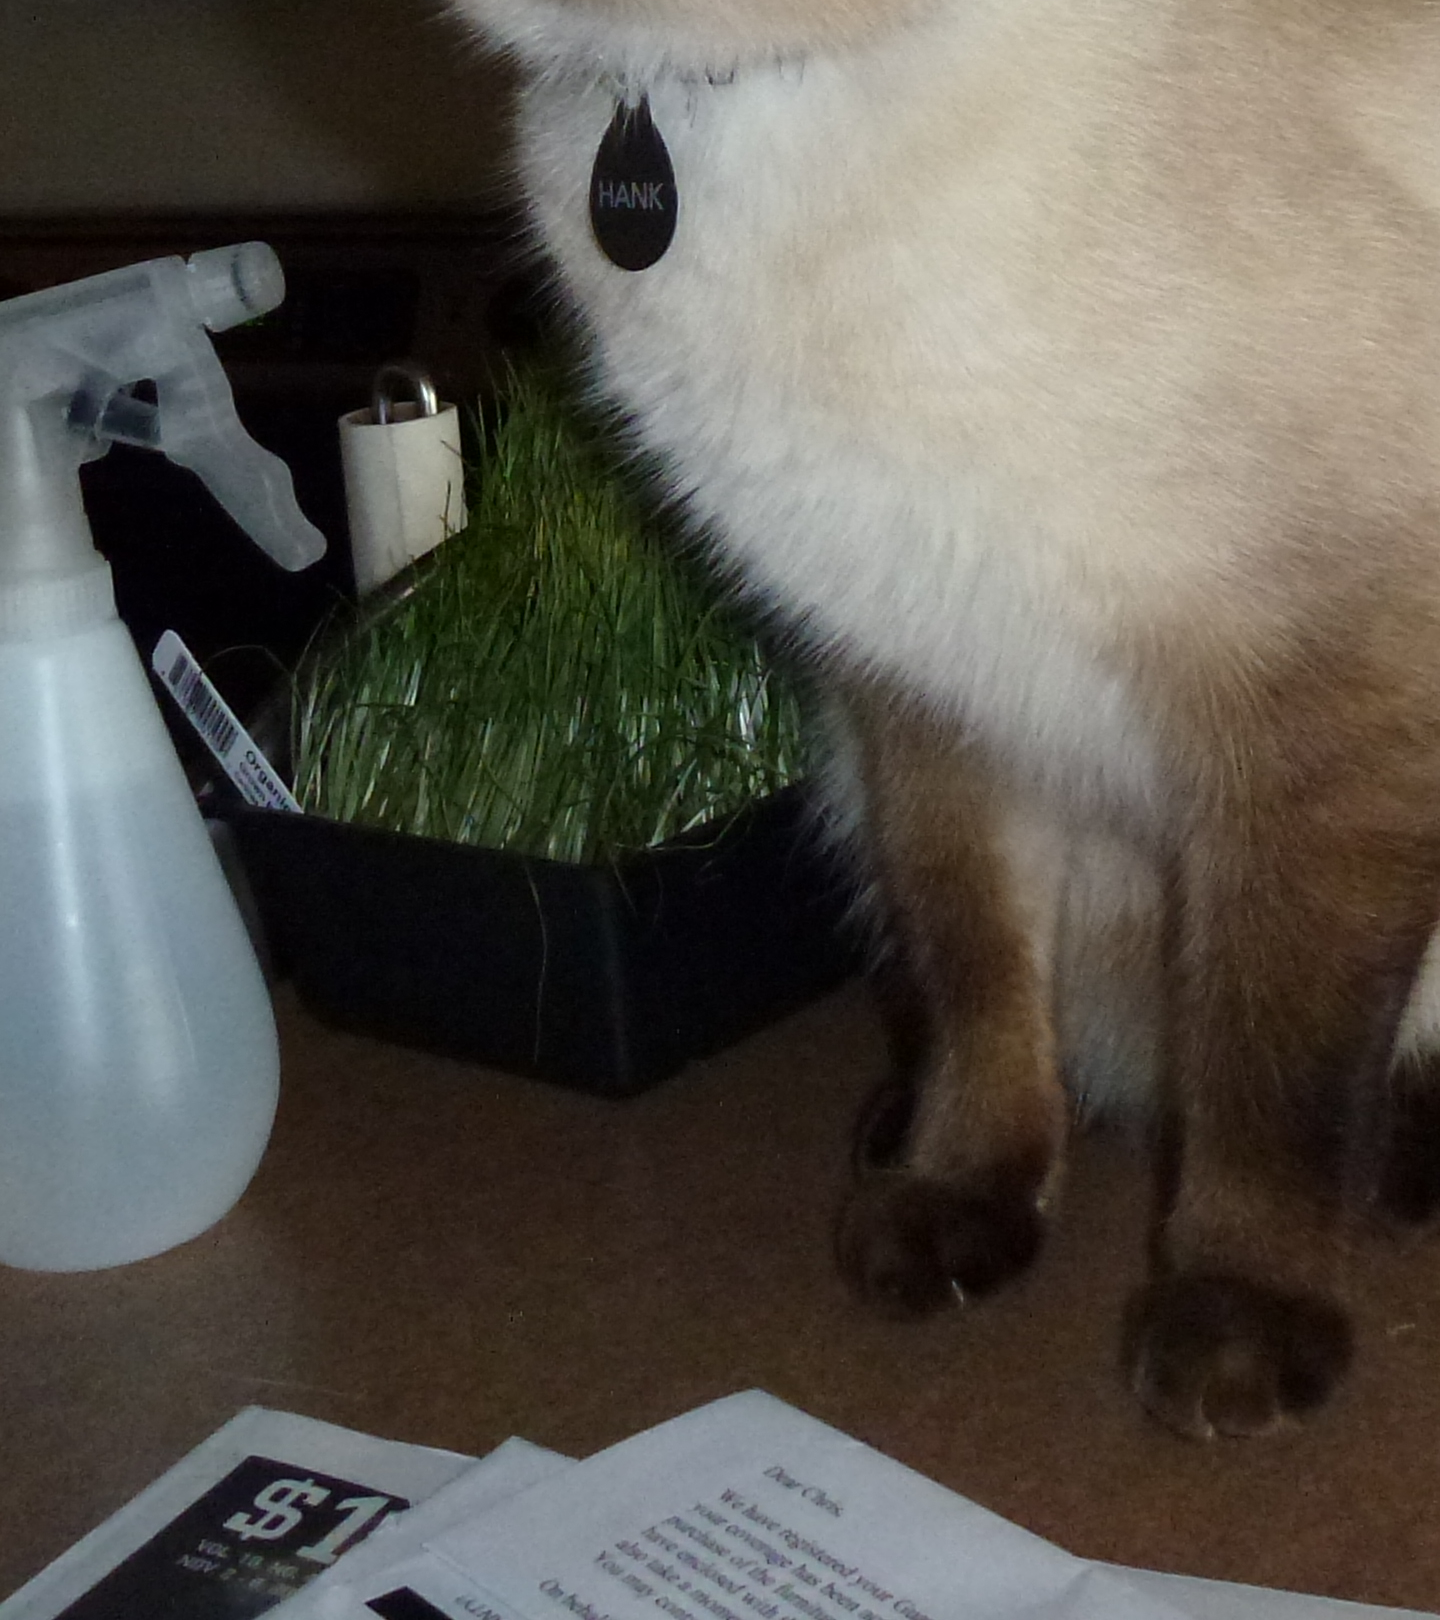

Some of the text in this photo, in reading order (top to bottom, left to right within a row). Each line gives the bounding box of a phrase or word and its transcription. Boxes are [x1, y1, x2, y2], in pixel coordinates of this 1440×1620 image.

[598, 181, 664, 211] HANK
[763, 1466, 802, 1490] Dear
[640, 1525, 679, 1552] have
[720, 1488, 744, 1510] We
[741, 1504, 781, 1531] have
[778, 1528, 859, 1577] registered
[848, 1576, 894, 1602] your
[594, 1550, 625, 1577] You
[615, 1540, 649, 1562] also
[646, 1559, 680, 1583] take
[688, 1501, 728, 1526] your
[792, 1563, 822, 1586] has
[820, 1582, 860, 1612] been
[747, 1566, 776, 1586] the
